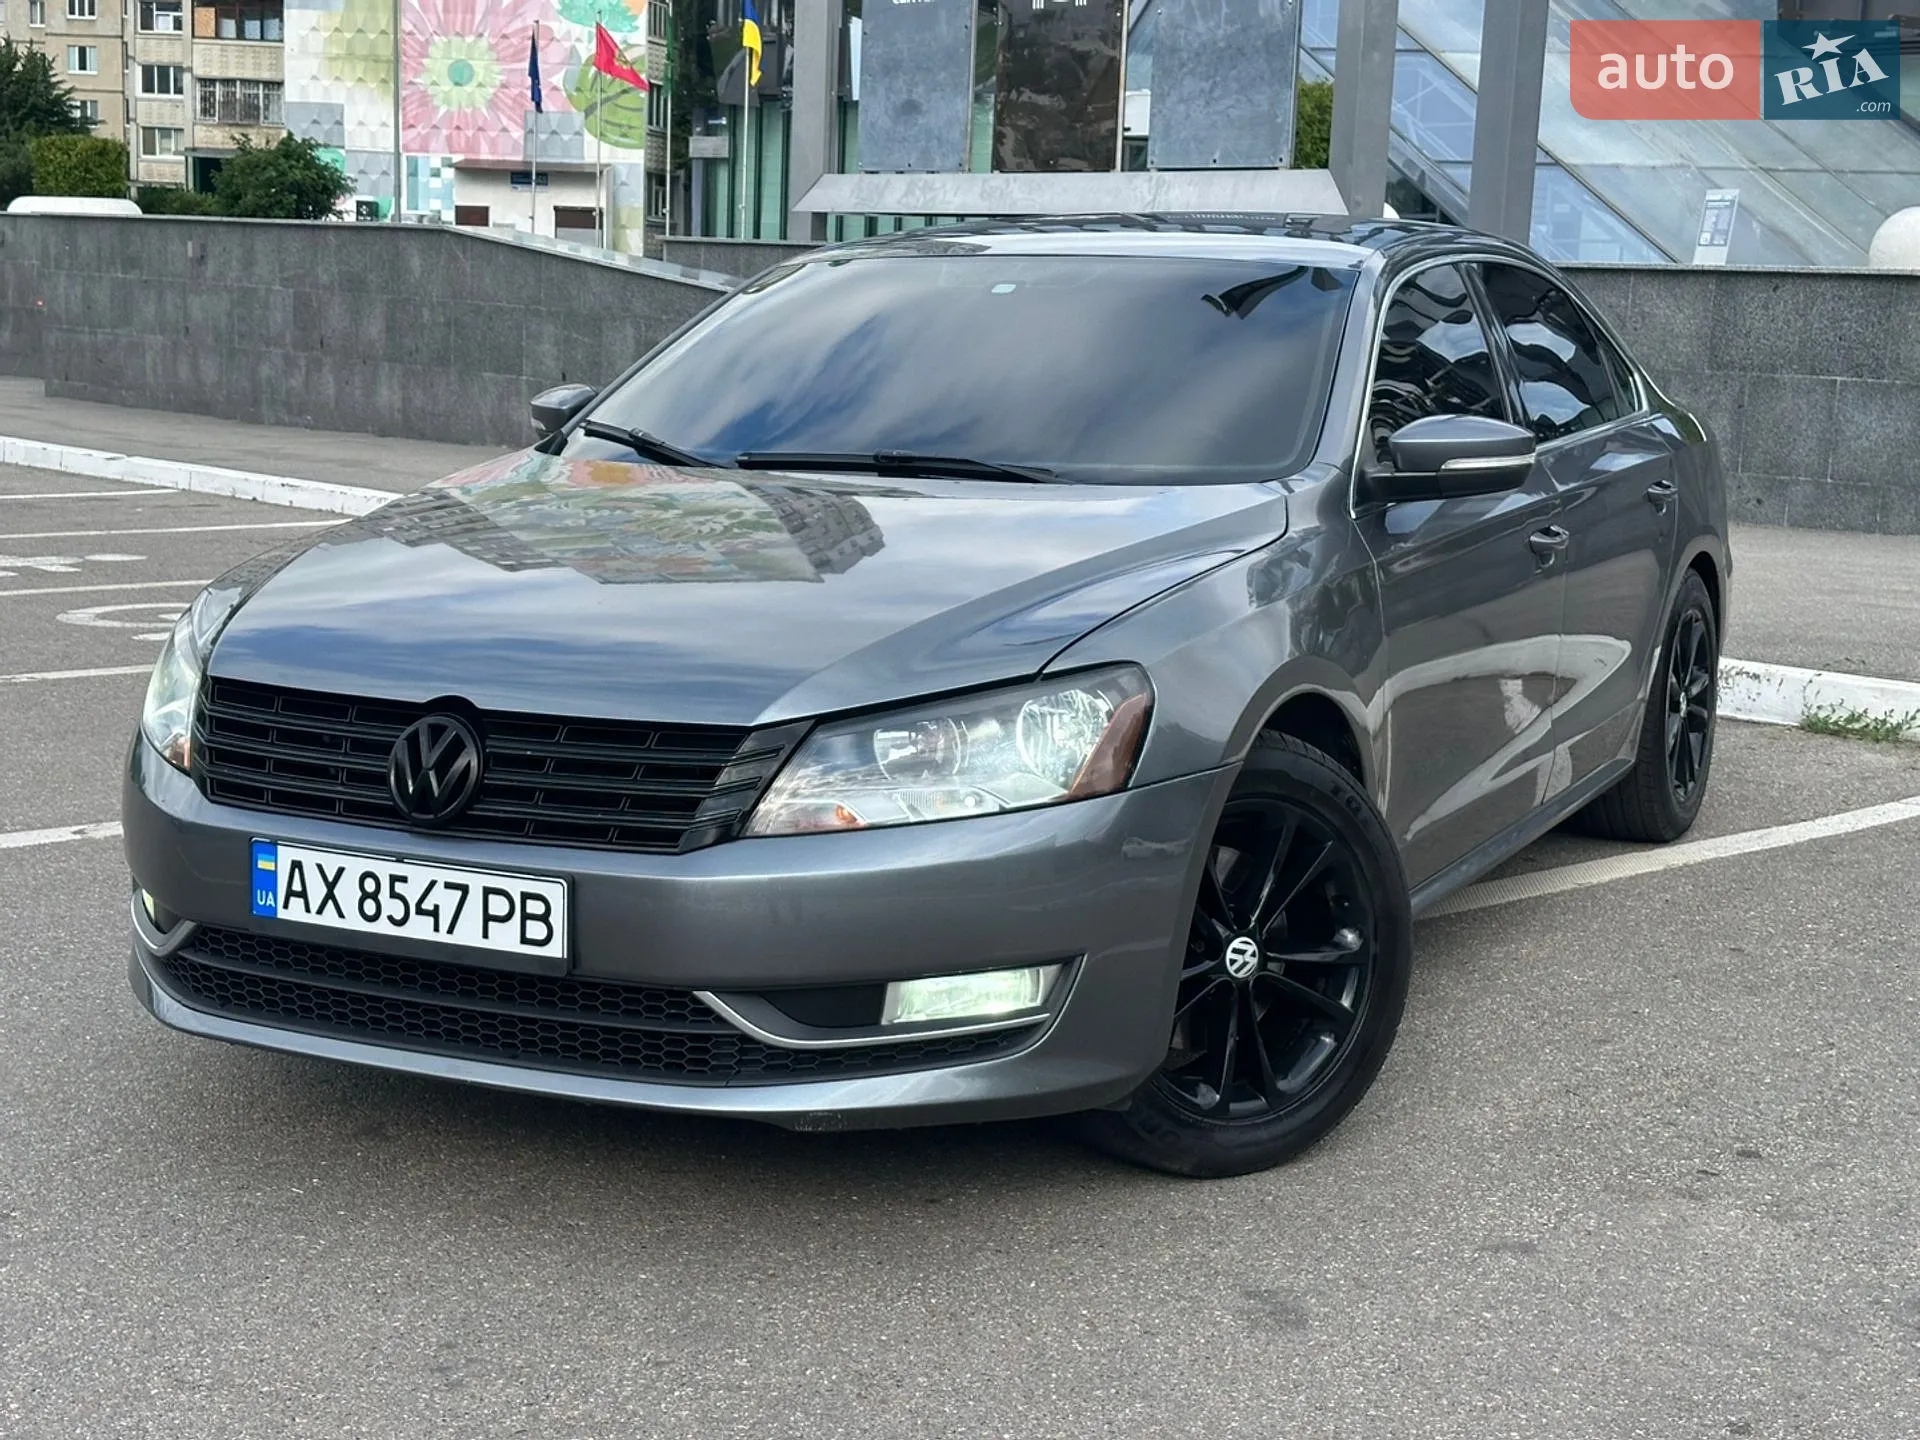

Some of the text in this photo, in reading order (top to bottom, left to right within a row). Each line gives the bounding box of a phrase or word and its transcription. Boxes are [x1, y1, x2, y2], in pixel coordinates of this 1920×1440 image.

[256, 889, 276, 907] UA
[282, 860, 554, 947] AX 8547 PB
